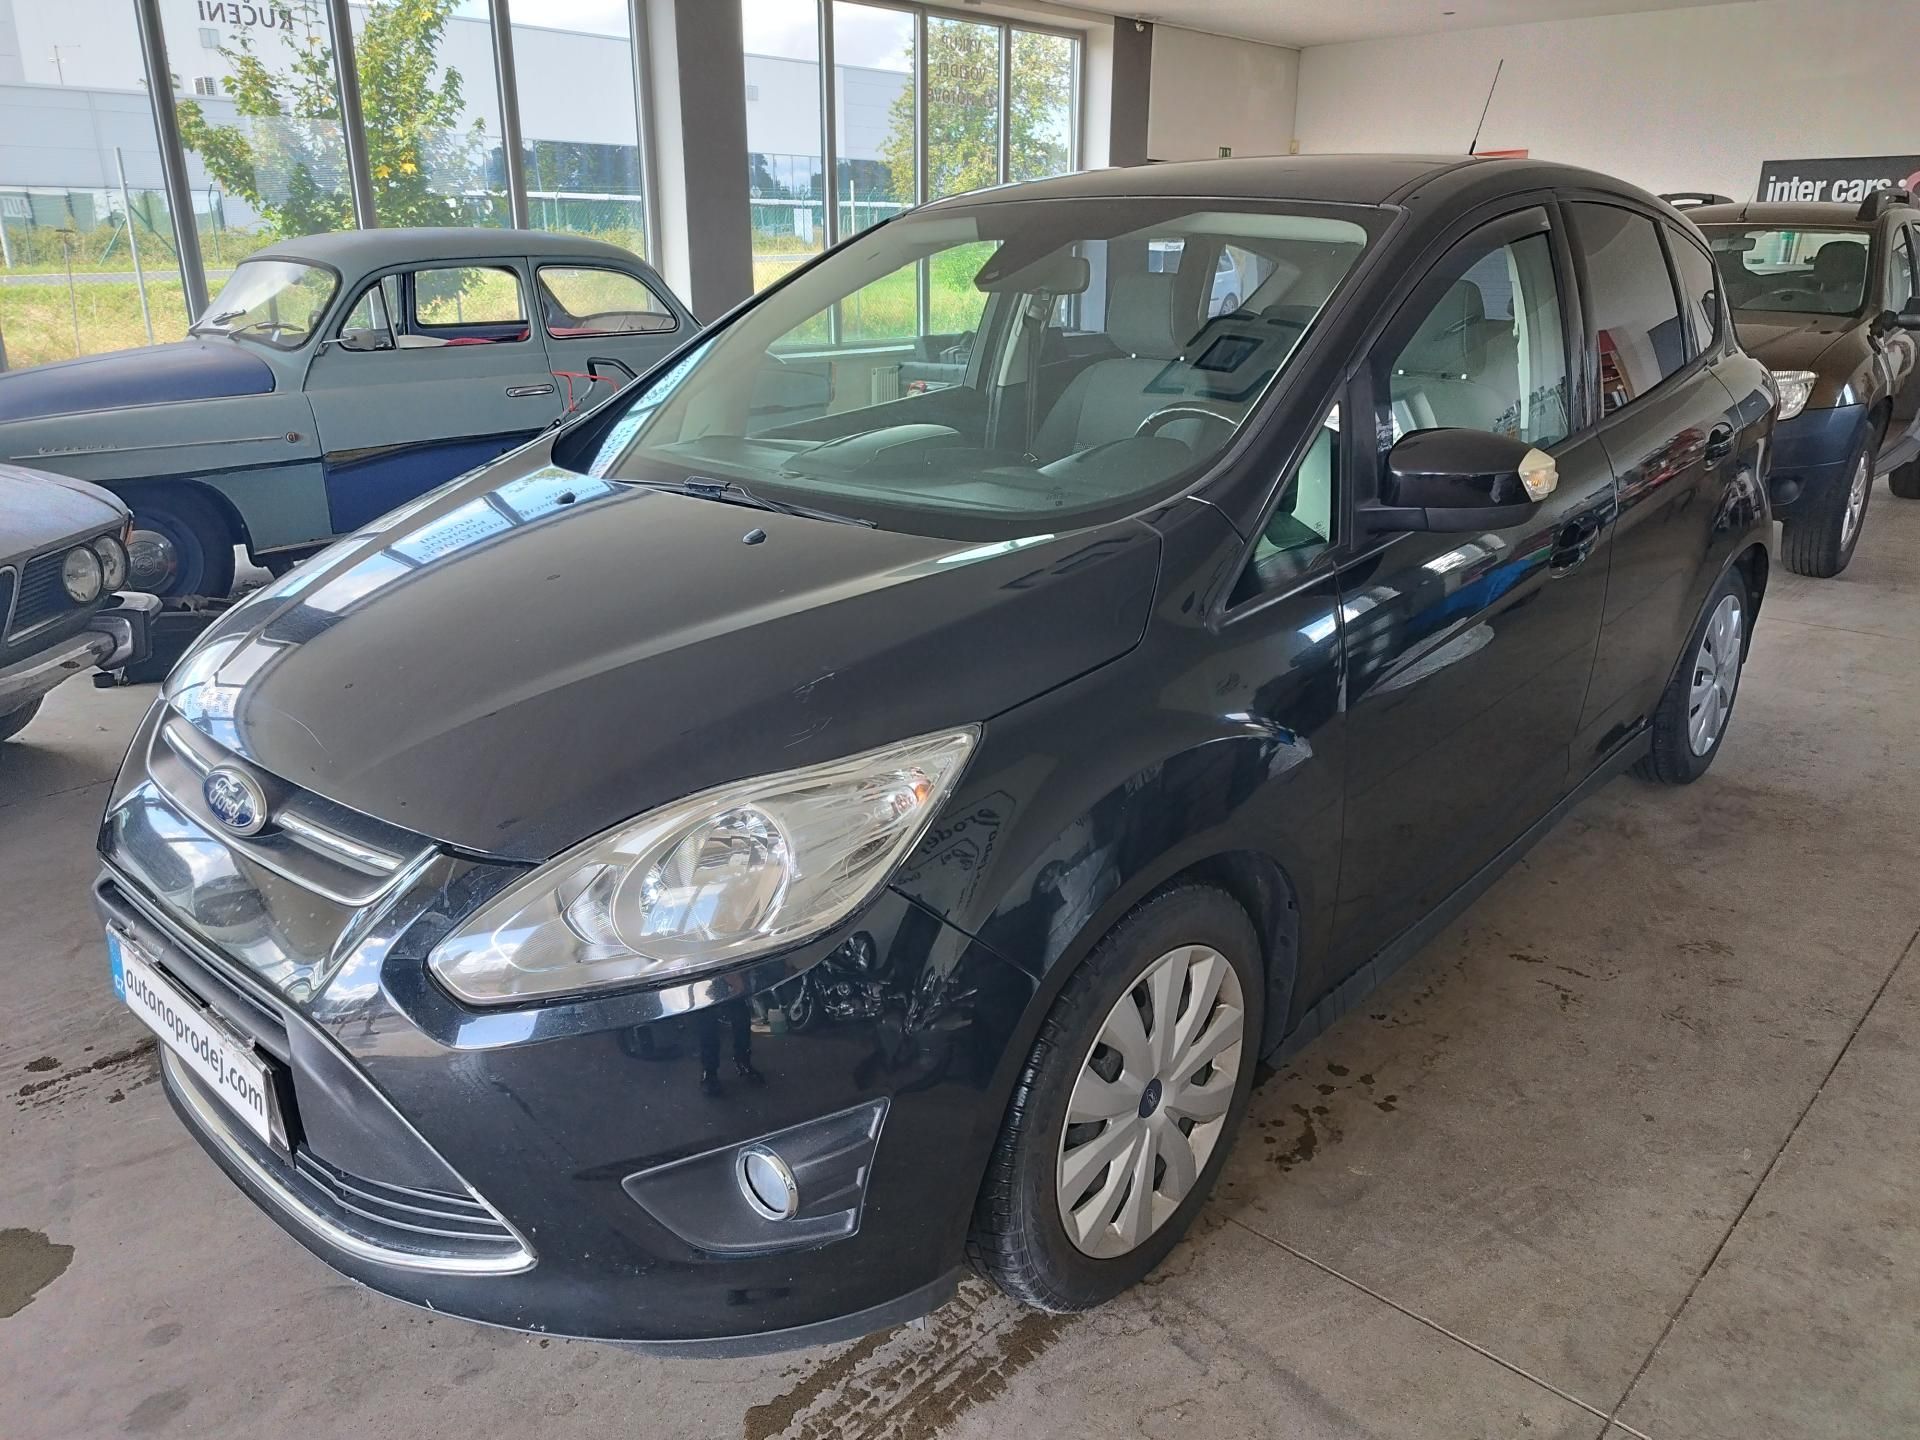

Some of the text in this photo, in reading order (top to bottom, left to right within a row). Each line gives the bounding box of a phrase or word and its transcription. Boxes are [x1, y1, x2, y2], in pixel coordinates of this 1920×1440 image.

[1766, 176, 1827, 202] inter
[209, 777, 244, 819] Ford
[115, 974, 125, 994] CZ
[126, 969, 263, 1116] autanaprodej.com
